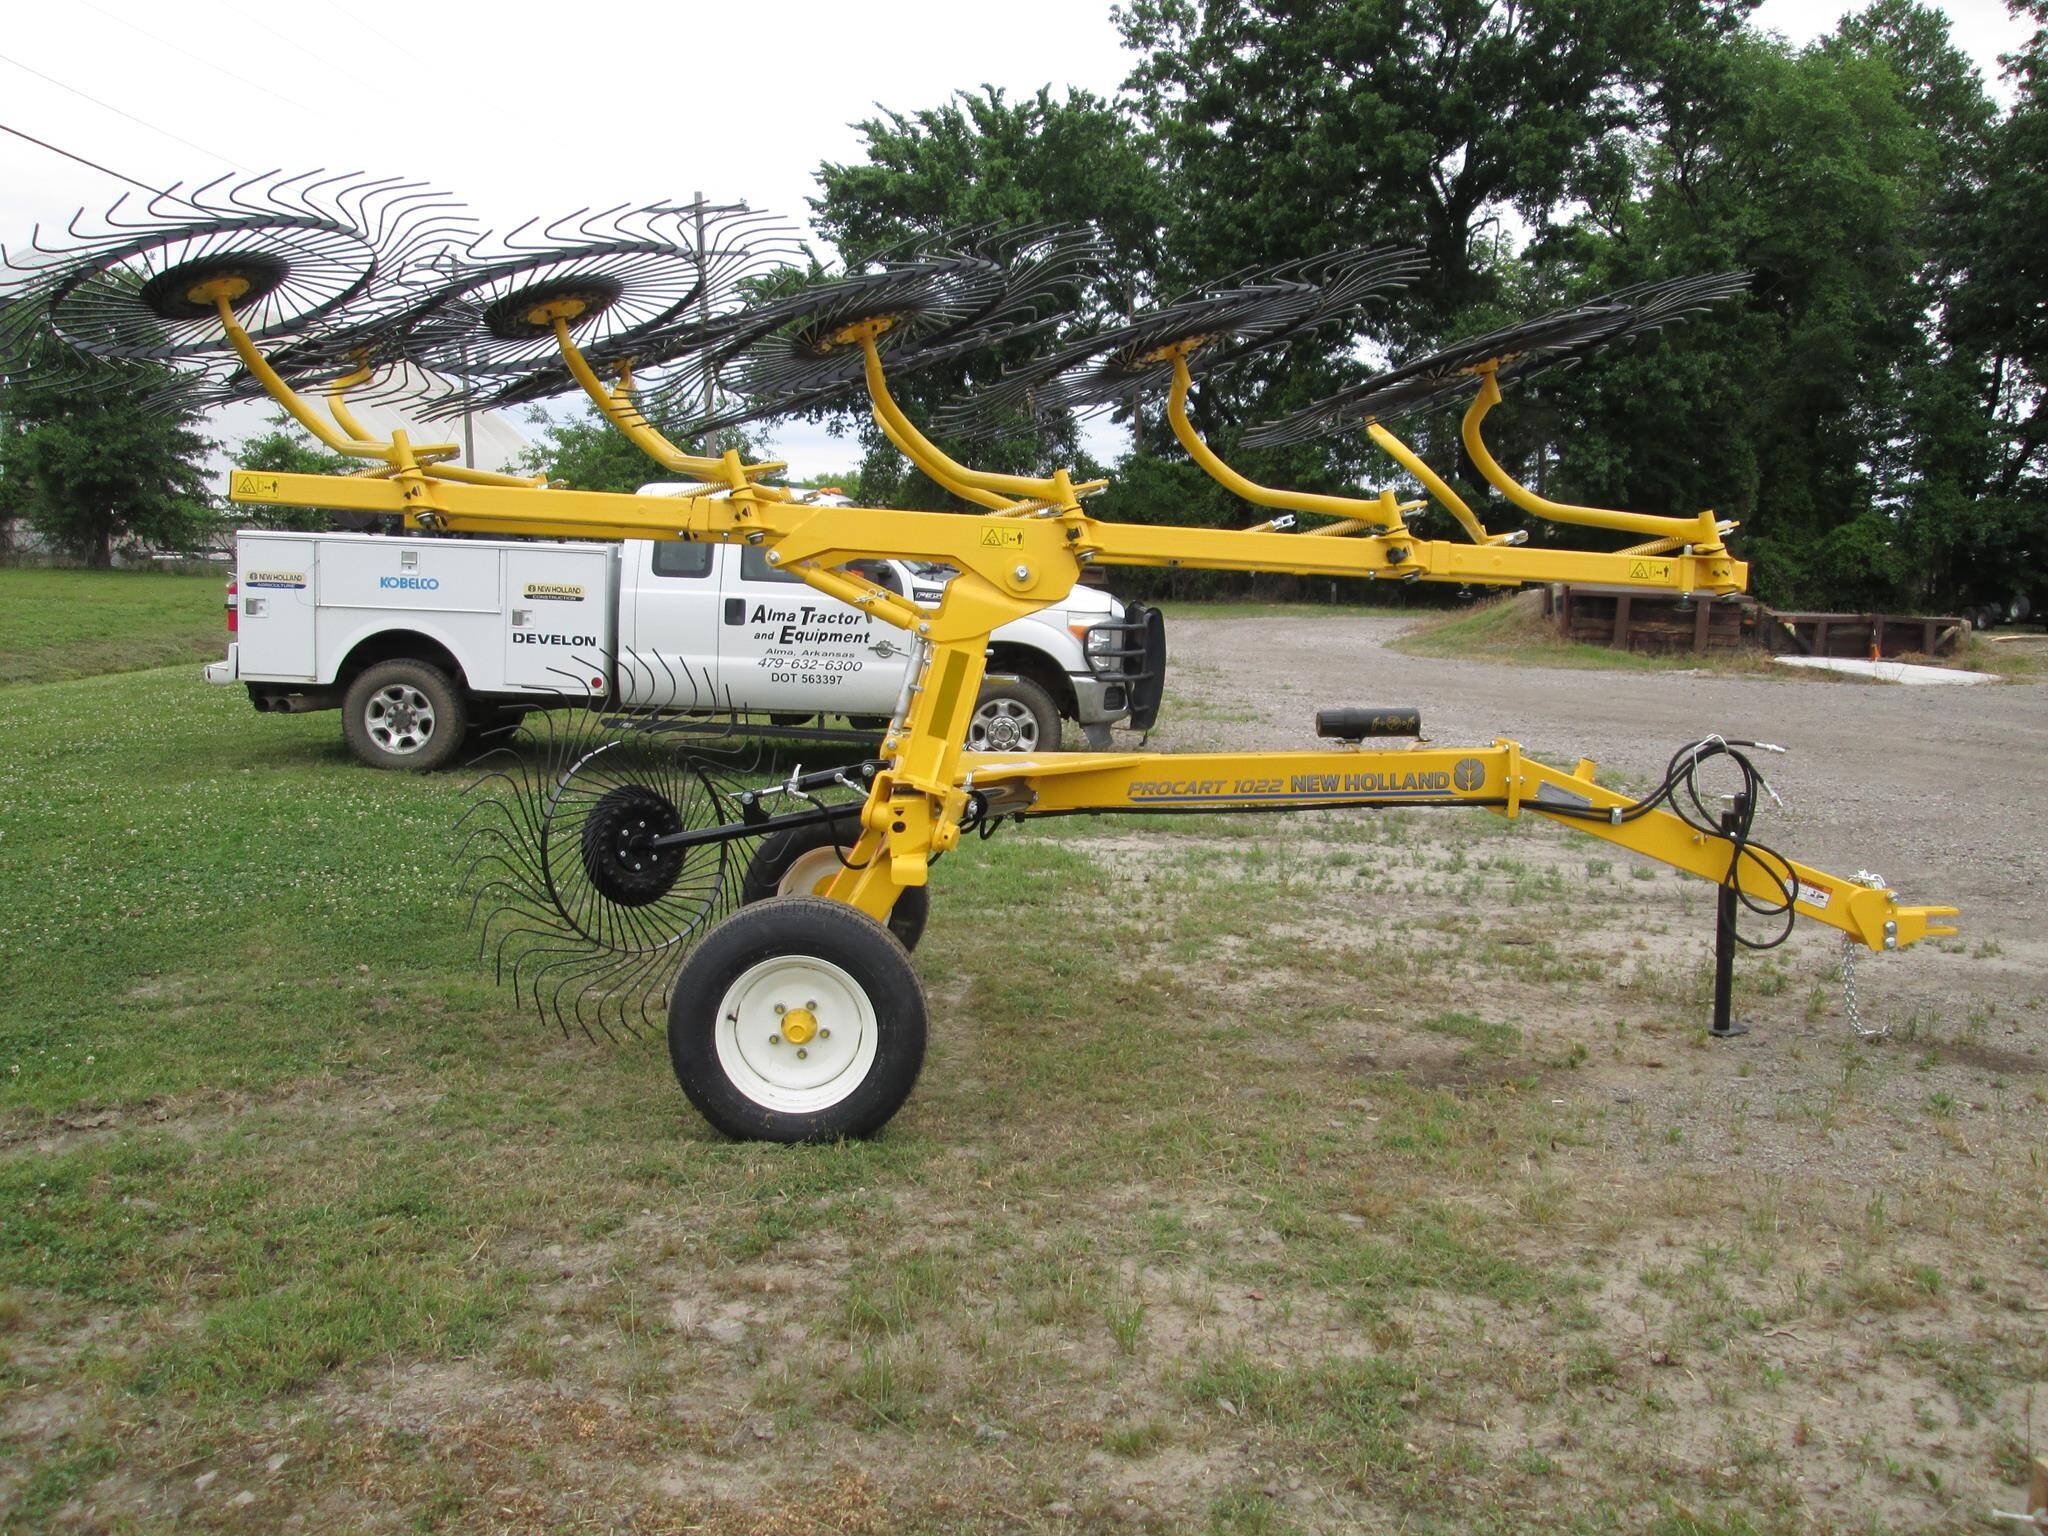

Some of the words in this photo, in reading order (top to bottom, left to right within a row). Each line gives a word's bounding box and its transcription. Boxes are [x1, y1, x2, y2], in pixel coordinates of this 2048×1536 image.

[273, 574, 303, 582] HOLLAND
[380, 576, 439, 590] KOBELCO
[552, 586, 581, 594] HOLLAND
[751, 604, 796, 623] Alma
[800, 606, 862, 626] Tractor
[512, 632, 596, 646] DEVELON
[754, 631, 775, 640] and
[779, 625, 870, 644] Equipment
[765, 648, 797, 657] Alma,
[801, 649, 855, 658] Arkansas
[758, 657, 863, 671] 479-632-6300
[771, 673, 797, 683] DOT
[801, 674, 843, 685] 563397
[1127, 779, 1225, 796] PROCART
[1233, 778, 1283, 795] 1022
[1290, 774, 1341, 793] NEW
[1343, 771, 1451, 792] HOLLAND
